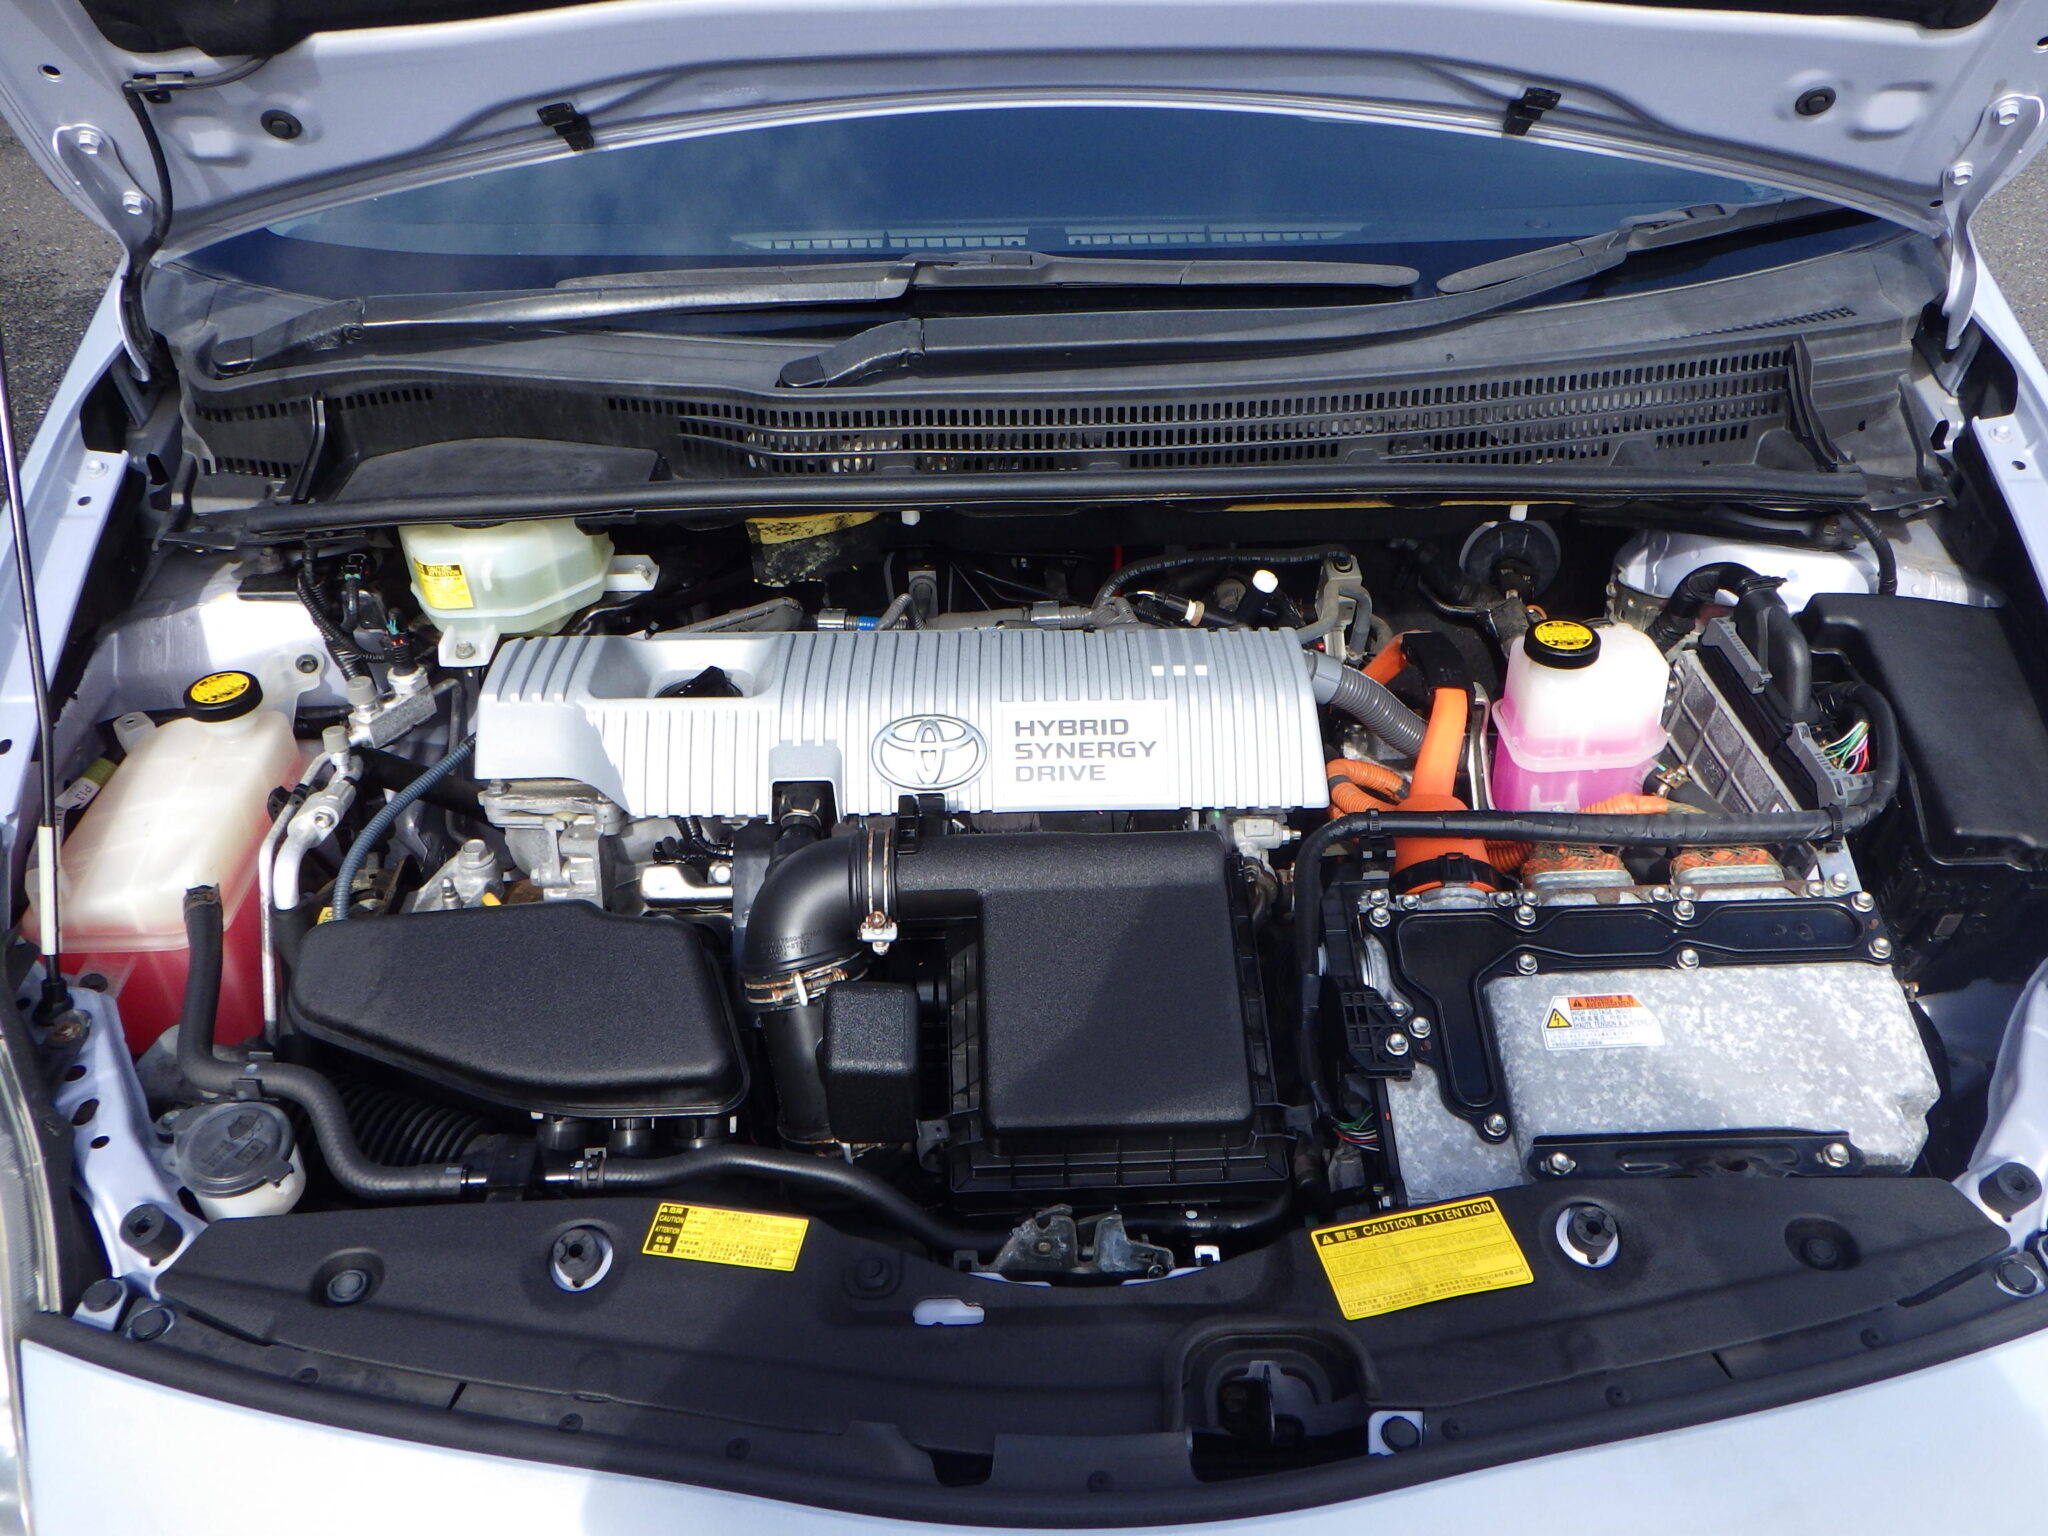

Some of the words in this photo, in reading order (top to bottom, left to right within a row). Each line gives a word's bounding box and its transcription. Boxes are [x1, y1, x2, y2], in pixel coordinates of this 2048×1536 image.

[1015, 718, 1129, 737] HYBRID
[1014, 740, 1157, 759] SYNERGY
[1015, 764, 1106, 782] DRIVE
[659, 1214, 684, 1224] CAUTION
[1363, 1217, 1417, 1237] CAUTION
[1422, 1201, 1492, 1226] ATTENTION
[655, 1226, 680, 1235] ATTENTION
